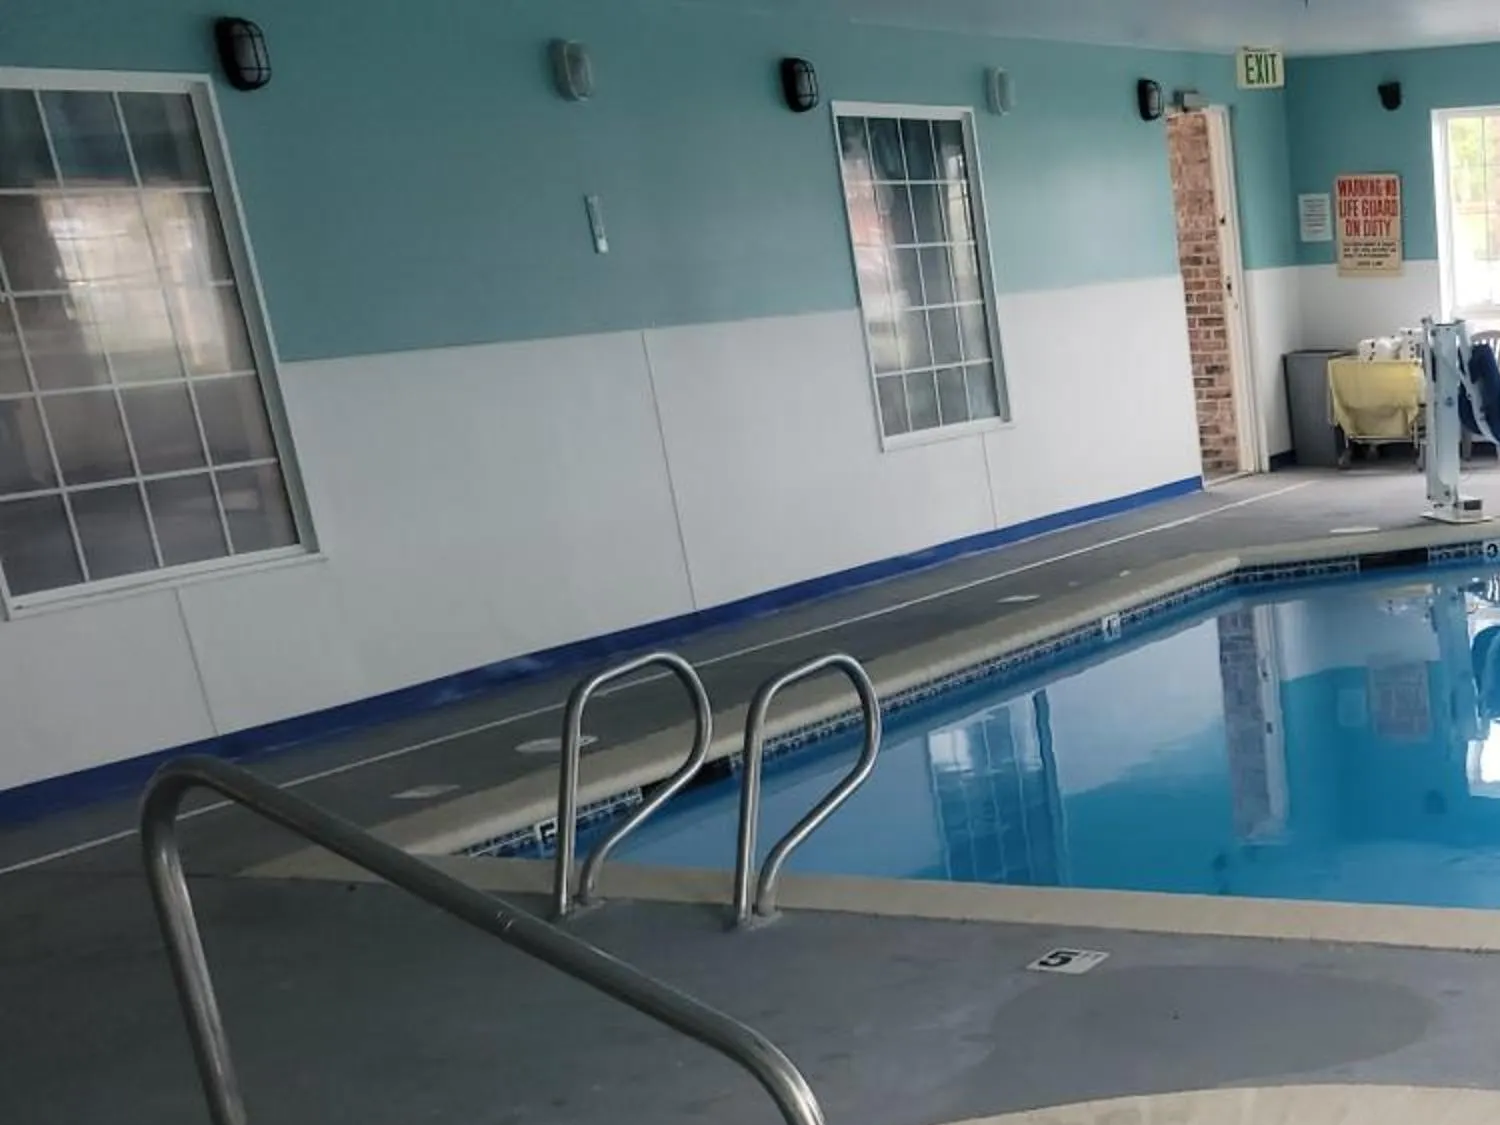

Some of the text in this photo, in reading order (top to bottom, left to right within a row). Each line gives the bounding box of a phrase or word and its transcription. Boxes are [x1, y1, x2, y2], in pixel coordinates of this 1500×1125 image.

[1245, 53, 1277, 85] EXIT
[1337, 178, 1382, 197] WARNING
[1339, 199, 1359, 218] LIFE
[1361, 199, 1398, 217] GUARD
[1345, 219, 1392, 237] ON DUTY
[1038, 950, 1080, 967] 5
